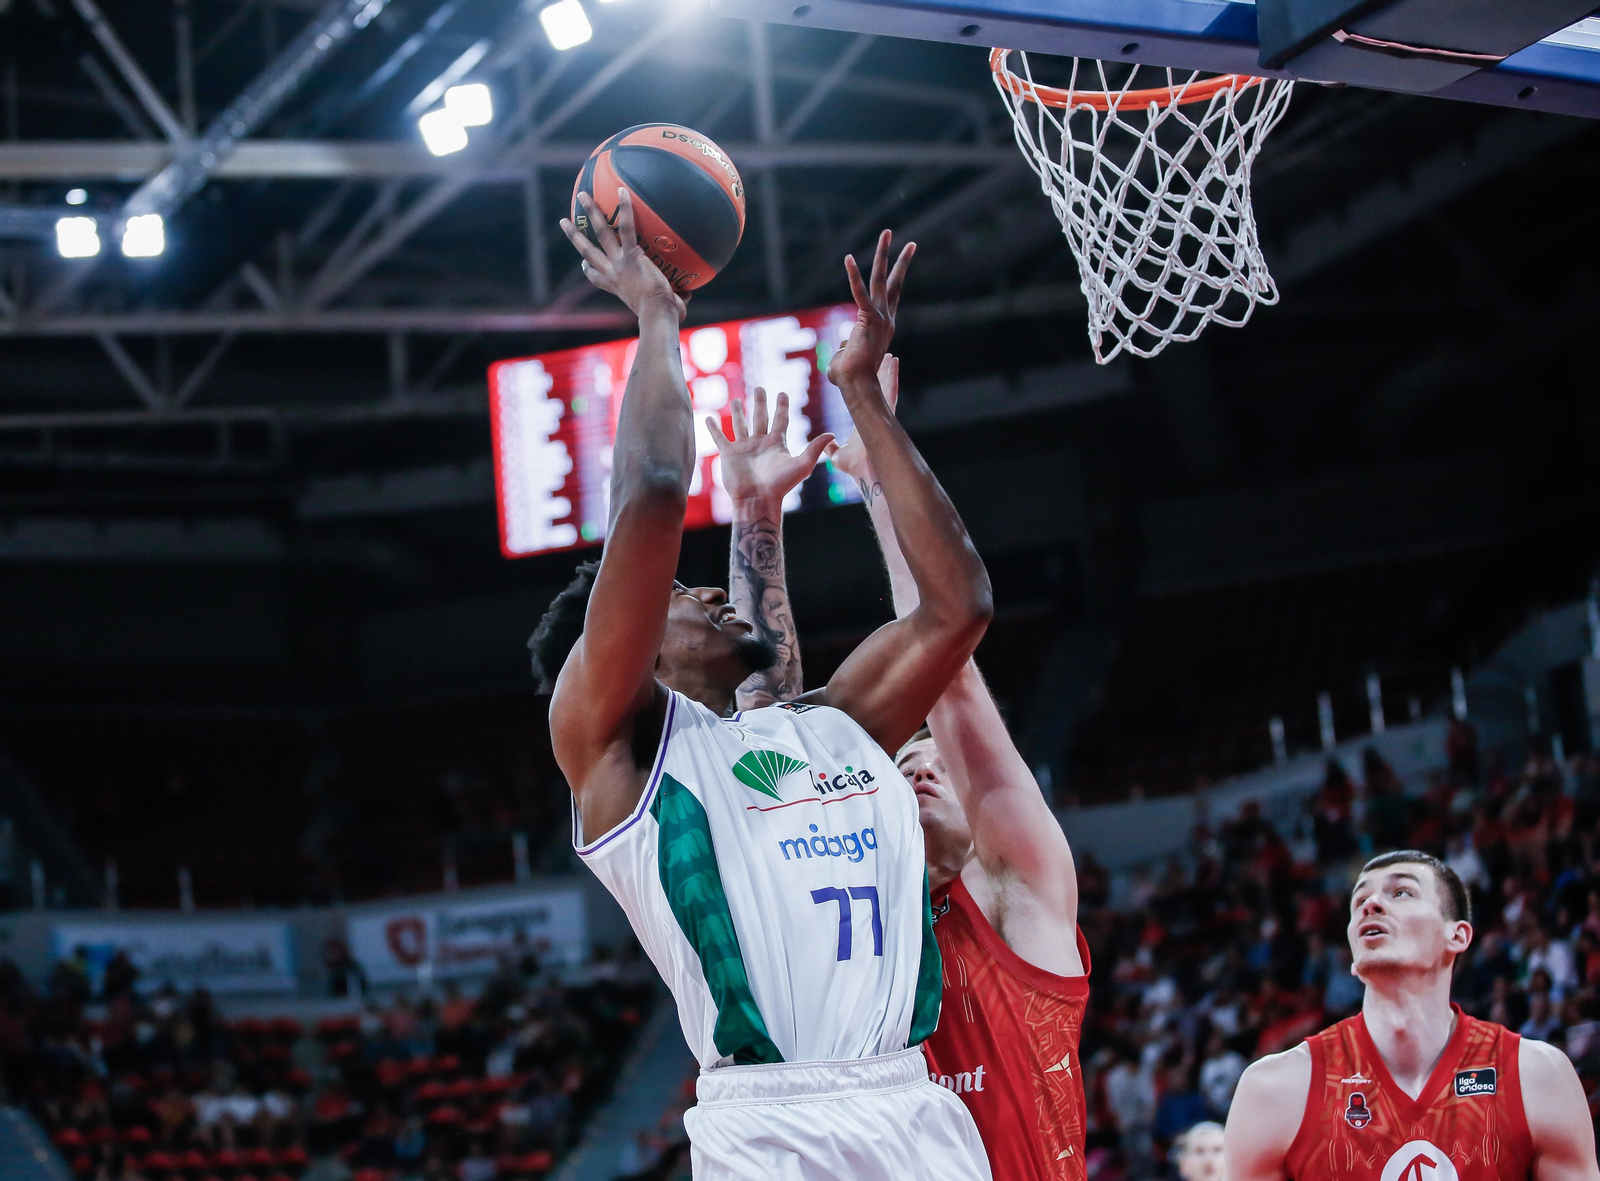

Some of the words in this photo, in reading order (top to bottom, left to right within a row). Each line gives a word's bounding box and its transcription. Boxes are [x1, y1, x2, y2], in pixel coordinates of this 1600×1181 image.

[810, 886, 883, 961] 77
[1458, 1077, 1476, 1086] liga
[1459, 1082, 1494, 1093] endesa
